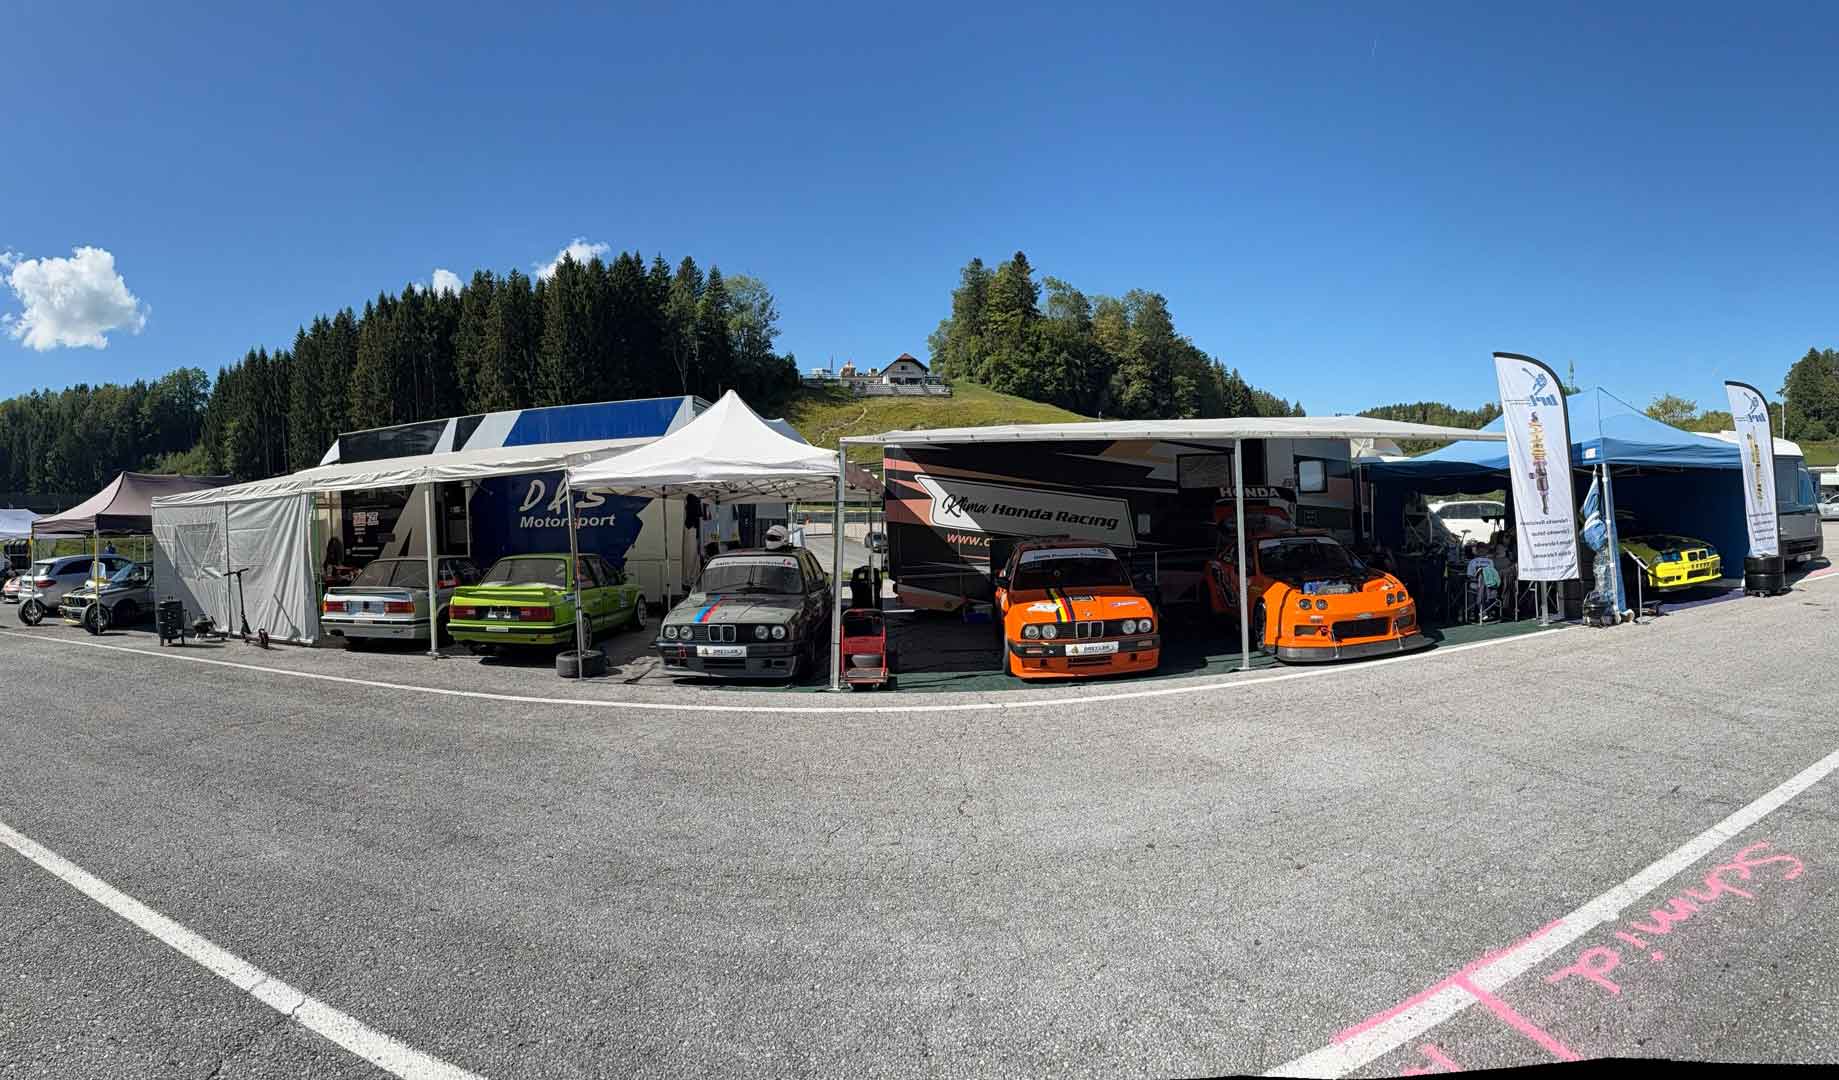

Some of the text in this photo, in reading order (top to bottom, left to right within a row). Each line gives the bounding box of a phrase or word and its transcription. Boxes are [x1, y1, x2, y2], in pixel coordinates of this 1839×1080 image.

[520, 513, 616, 529] Motorport
[942, 495, 1120, 530] Klima Honda Racing
[947, 533, 992, 548] www.c
[1546, 841, 1804, 995] Schmid
